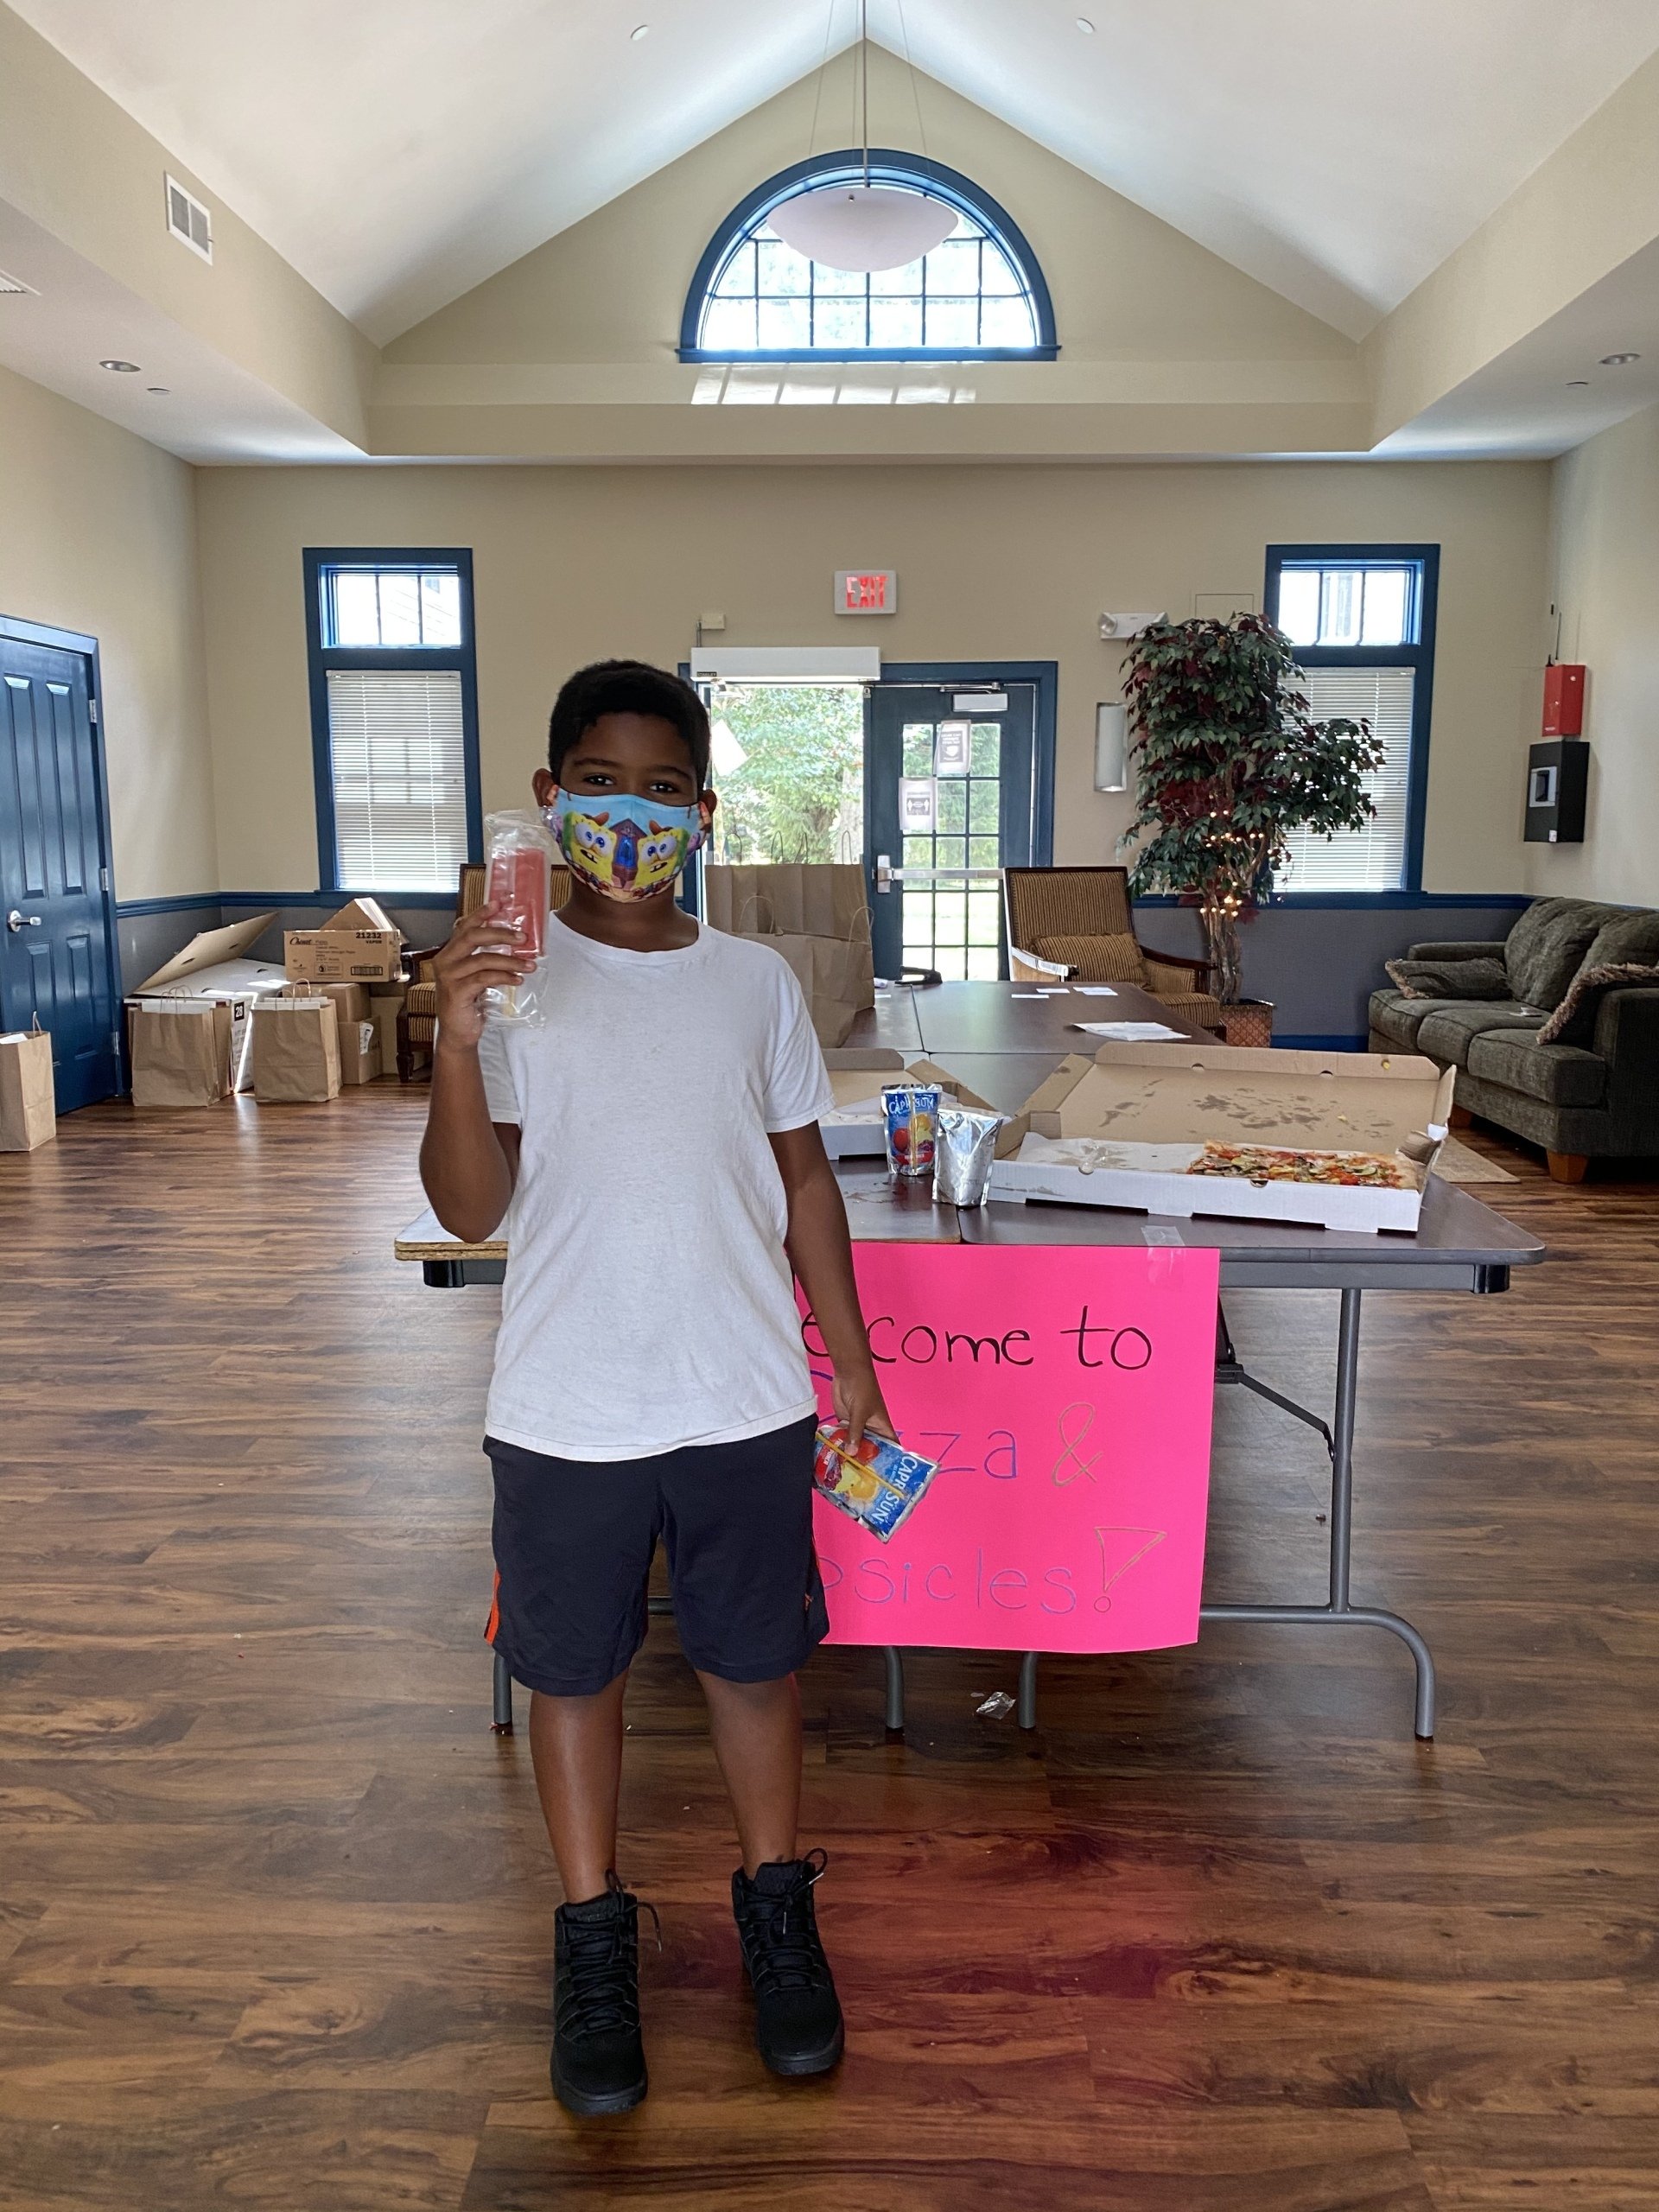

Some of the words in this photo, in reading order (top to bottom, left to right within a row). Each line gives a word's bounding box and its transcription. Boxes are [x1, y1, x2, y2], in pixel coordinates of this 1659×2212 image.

[846, 575, 887, 608] EXIT
[800, 1311, 1034, 1365] ecome
[1060, 1305, 1153, 1370] to
[1052, 1402, 1103, 1487] &
[895, 1455, 918, 1491] CAPR
[871, 1491, 899, 1523] SUN
